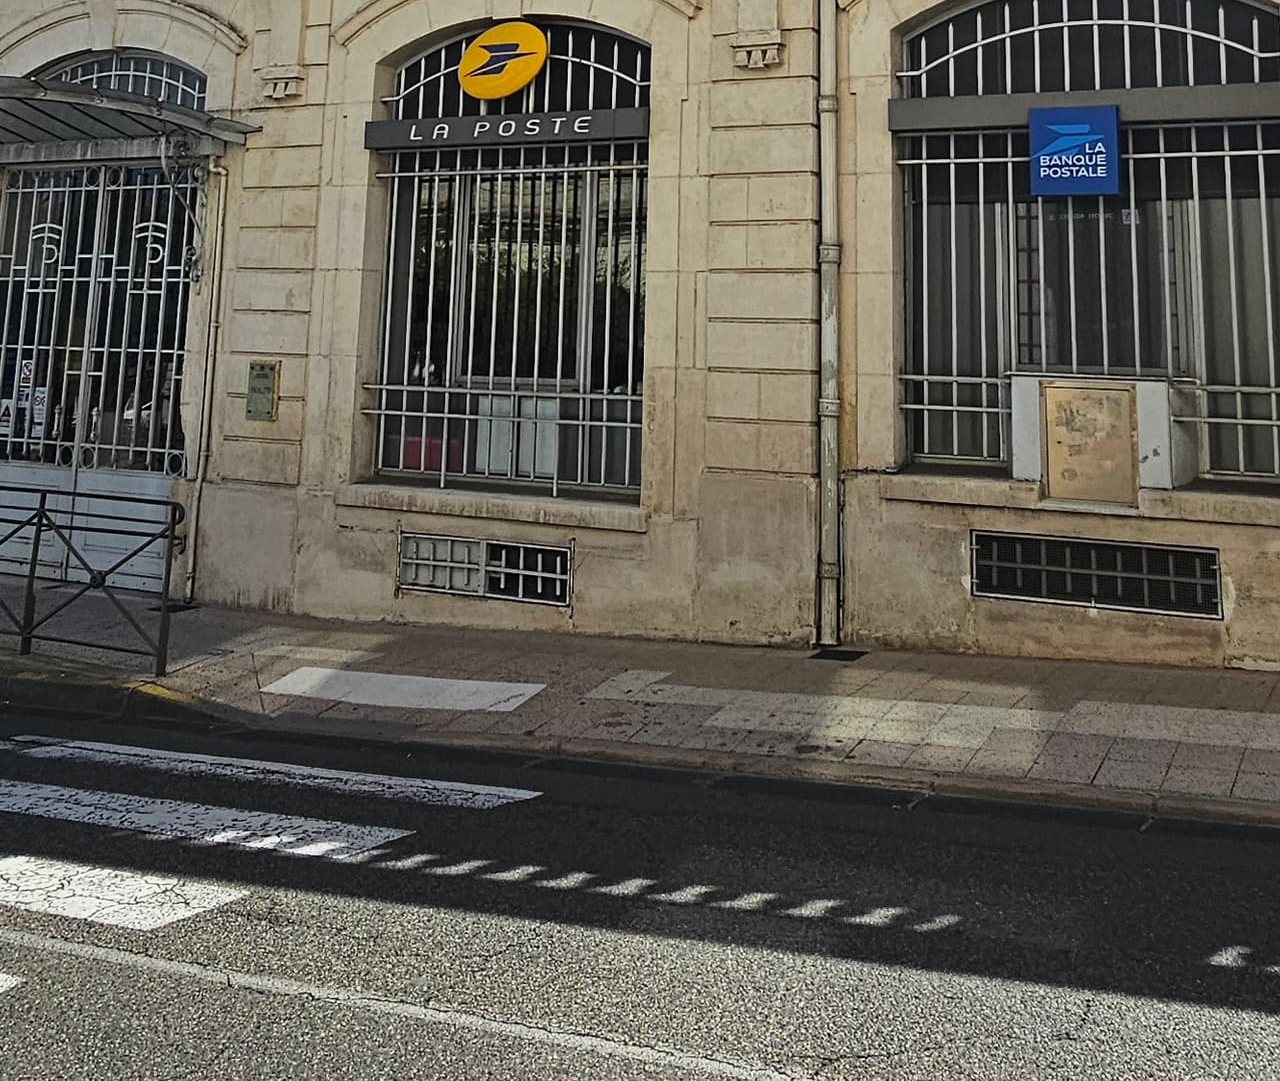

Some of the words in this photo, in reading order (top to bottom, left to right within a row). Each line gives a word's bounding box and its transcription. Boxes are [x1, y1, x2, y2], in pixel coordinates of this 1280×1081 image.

[409, 123, 450, 141] LA
[473, 116, 593, 138] POSTE
[1084, 142, 1107, 154] LA
[1039, 153, 1108, 167] BANQUE
[1039, 165, 1109, 179] POSTALE
